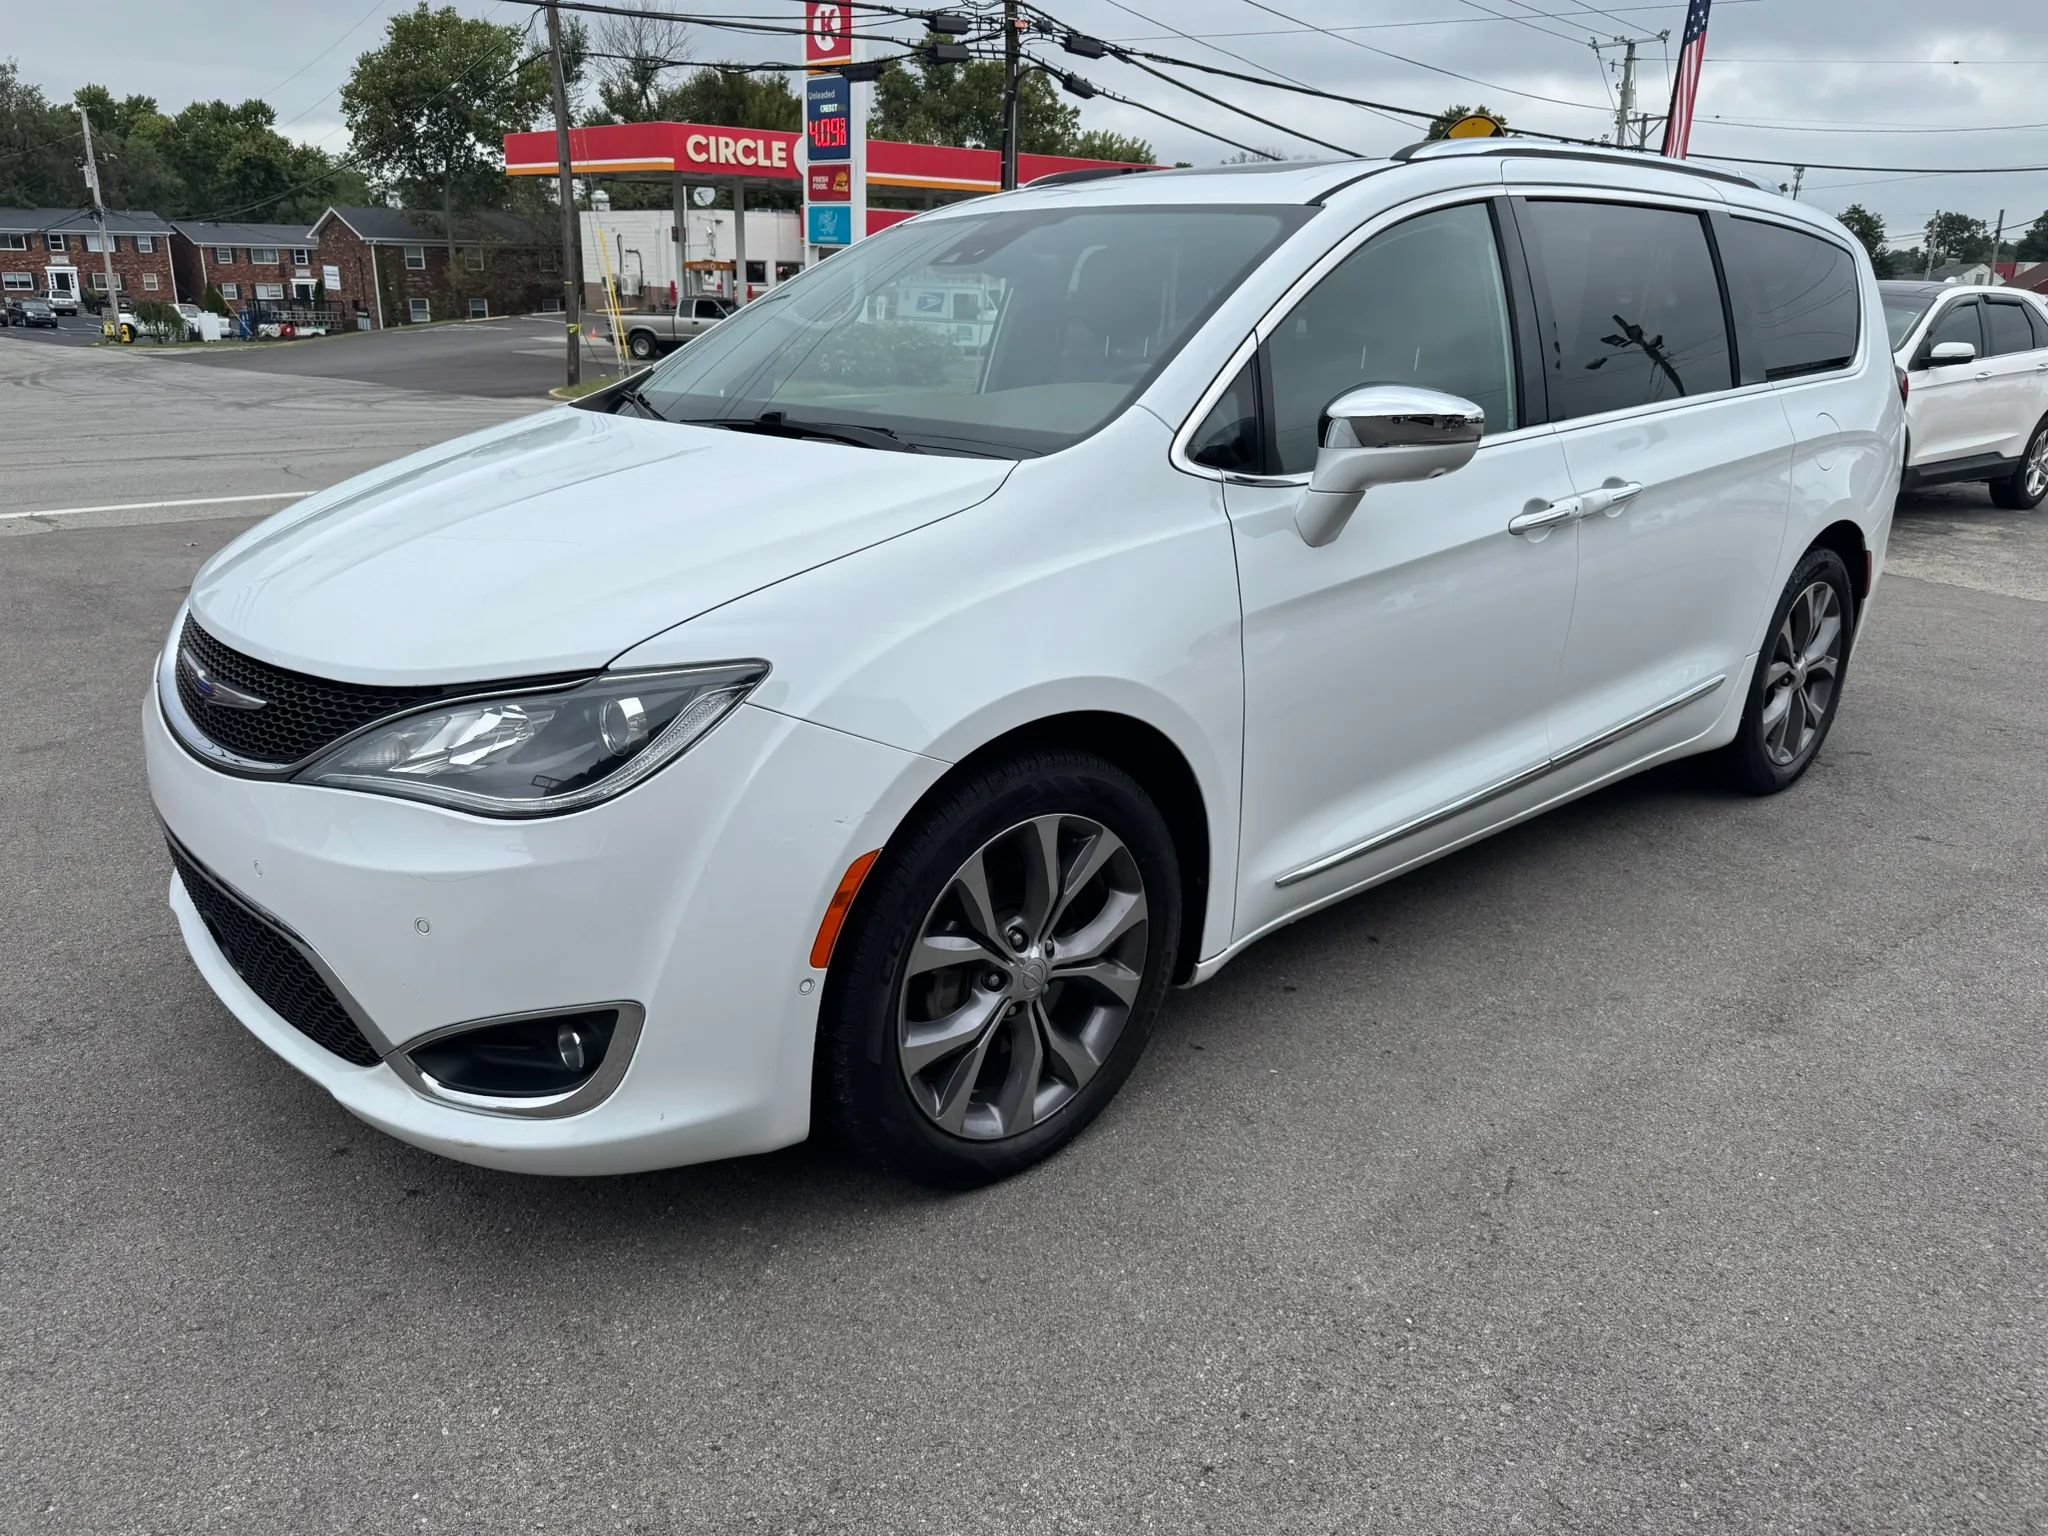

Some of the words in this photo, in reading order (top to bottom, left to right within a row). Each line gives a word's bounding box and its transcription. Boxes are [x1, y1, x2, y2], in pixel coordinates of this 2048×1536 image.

[808, 89, 836, 101] Unleaded
[686, 134, 788, 168] CIRCLE
[812, 175, 829, 183] FRESH
